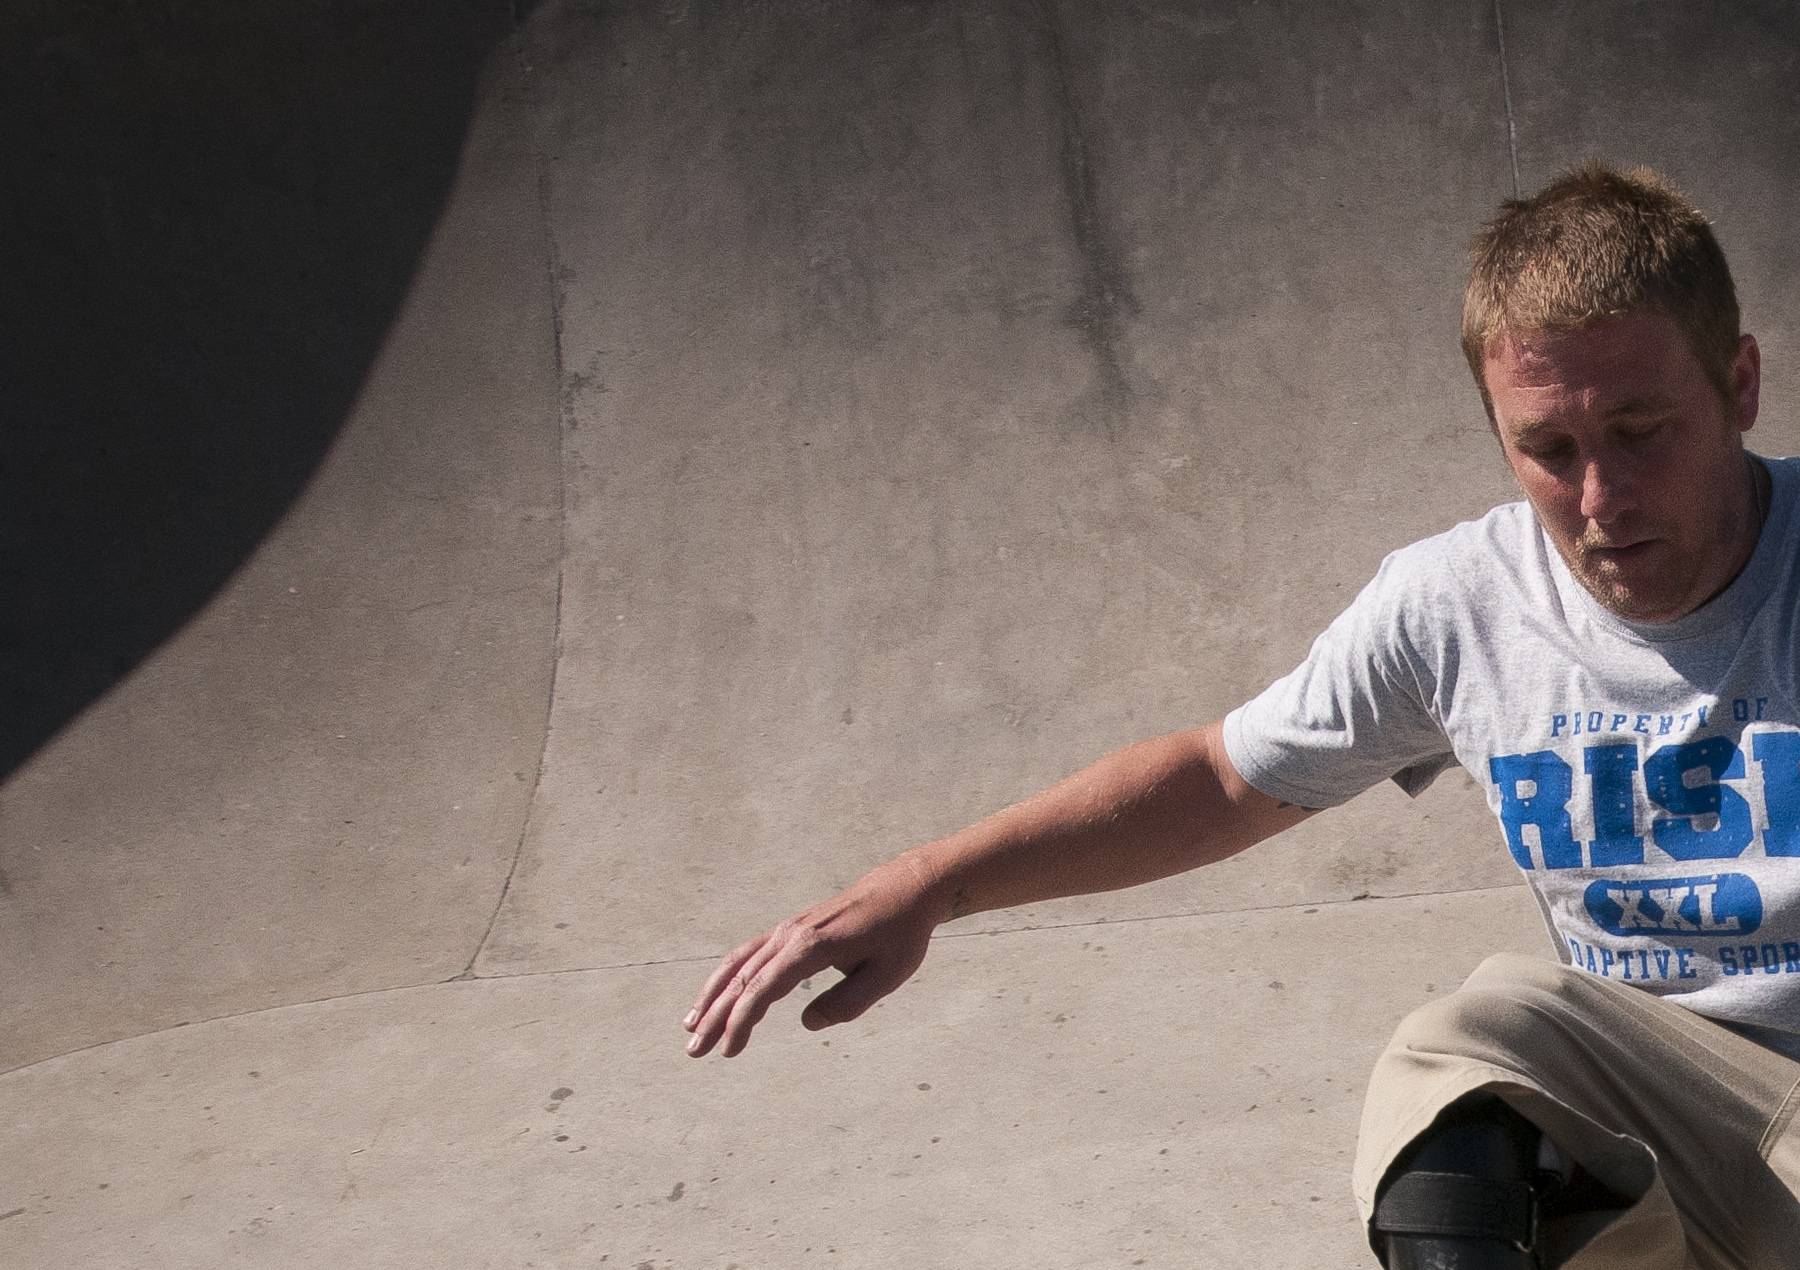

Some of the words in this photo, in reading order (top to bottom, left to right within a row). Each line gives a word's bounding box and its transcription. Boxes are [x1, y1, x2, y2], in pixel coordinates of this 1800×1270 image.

[1732, 697, 1768, 722] OF
[1606, 883, 1740, 931] XXL
[1562, 932, 1697, 979] DAPTIVE
